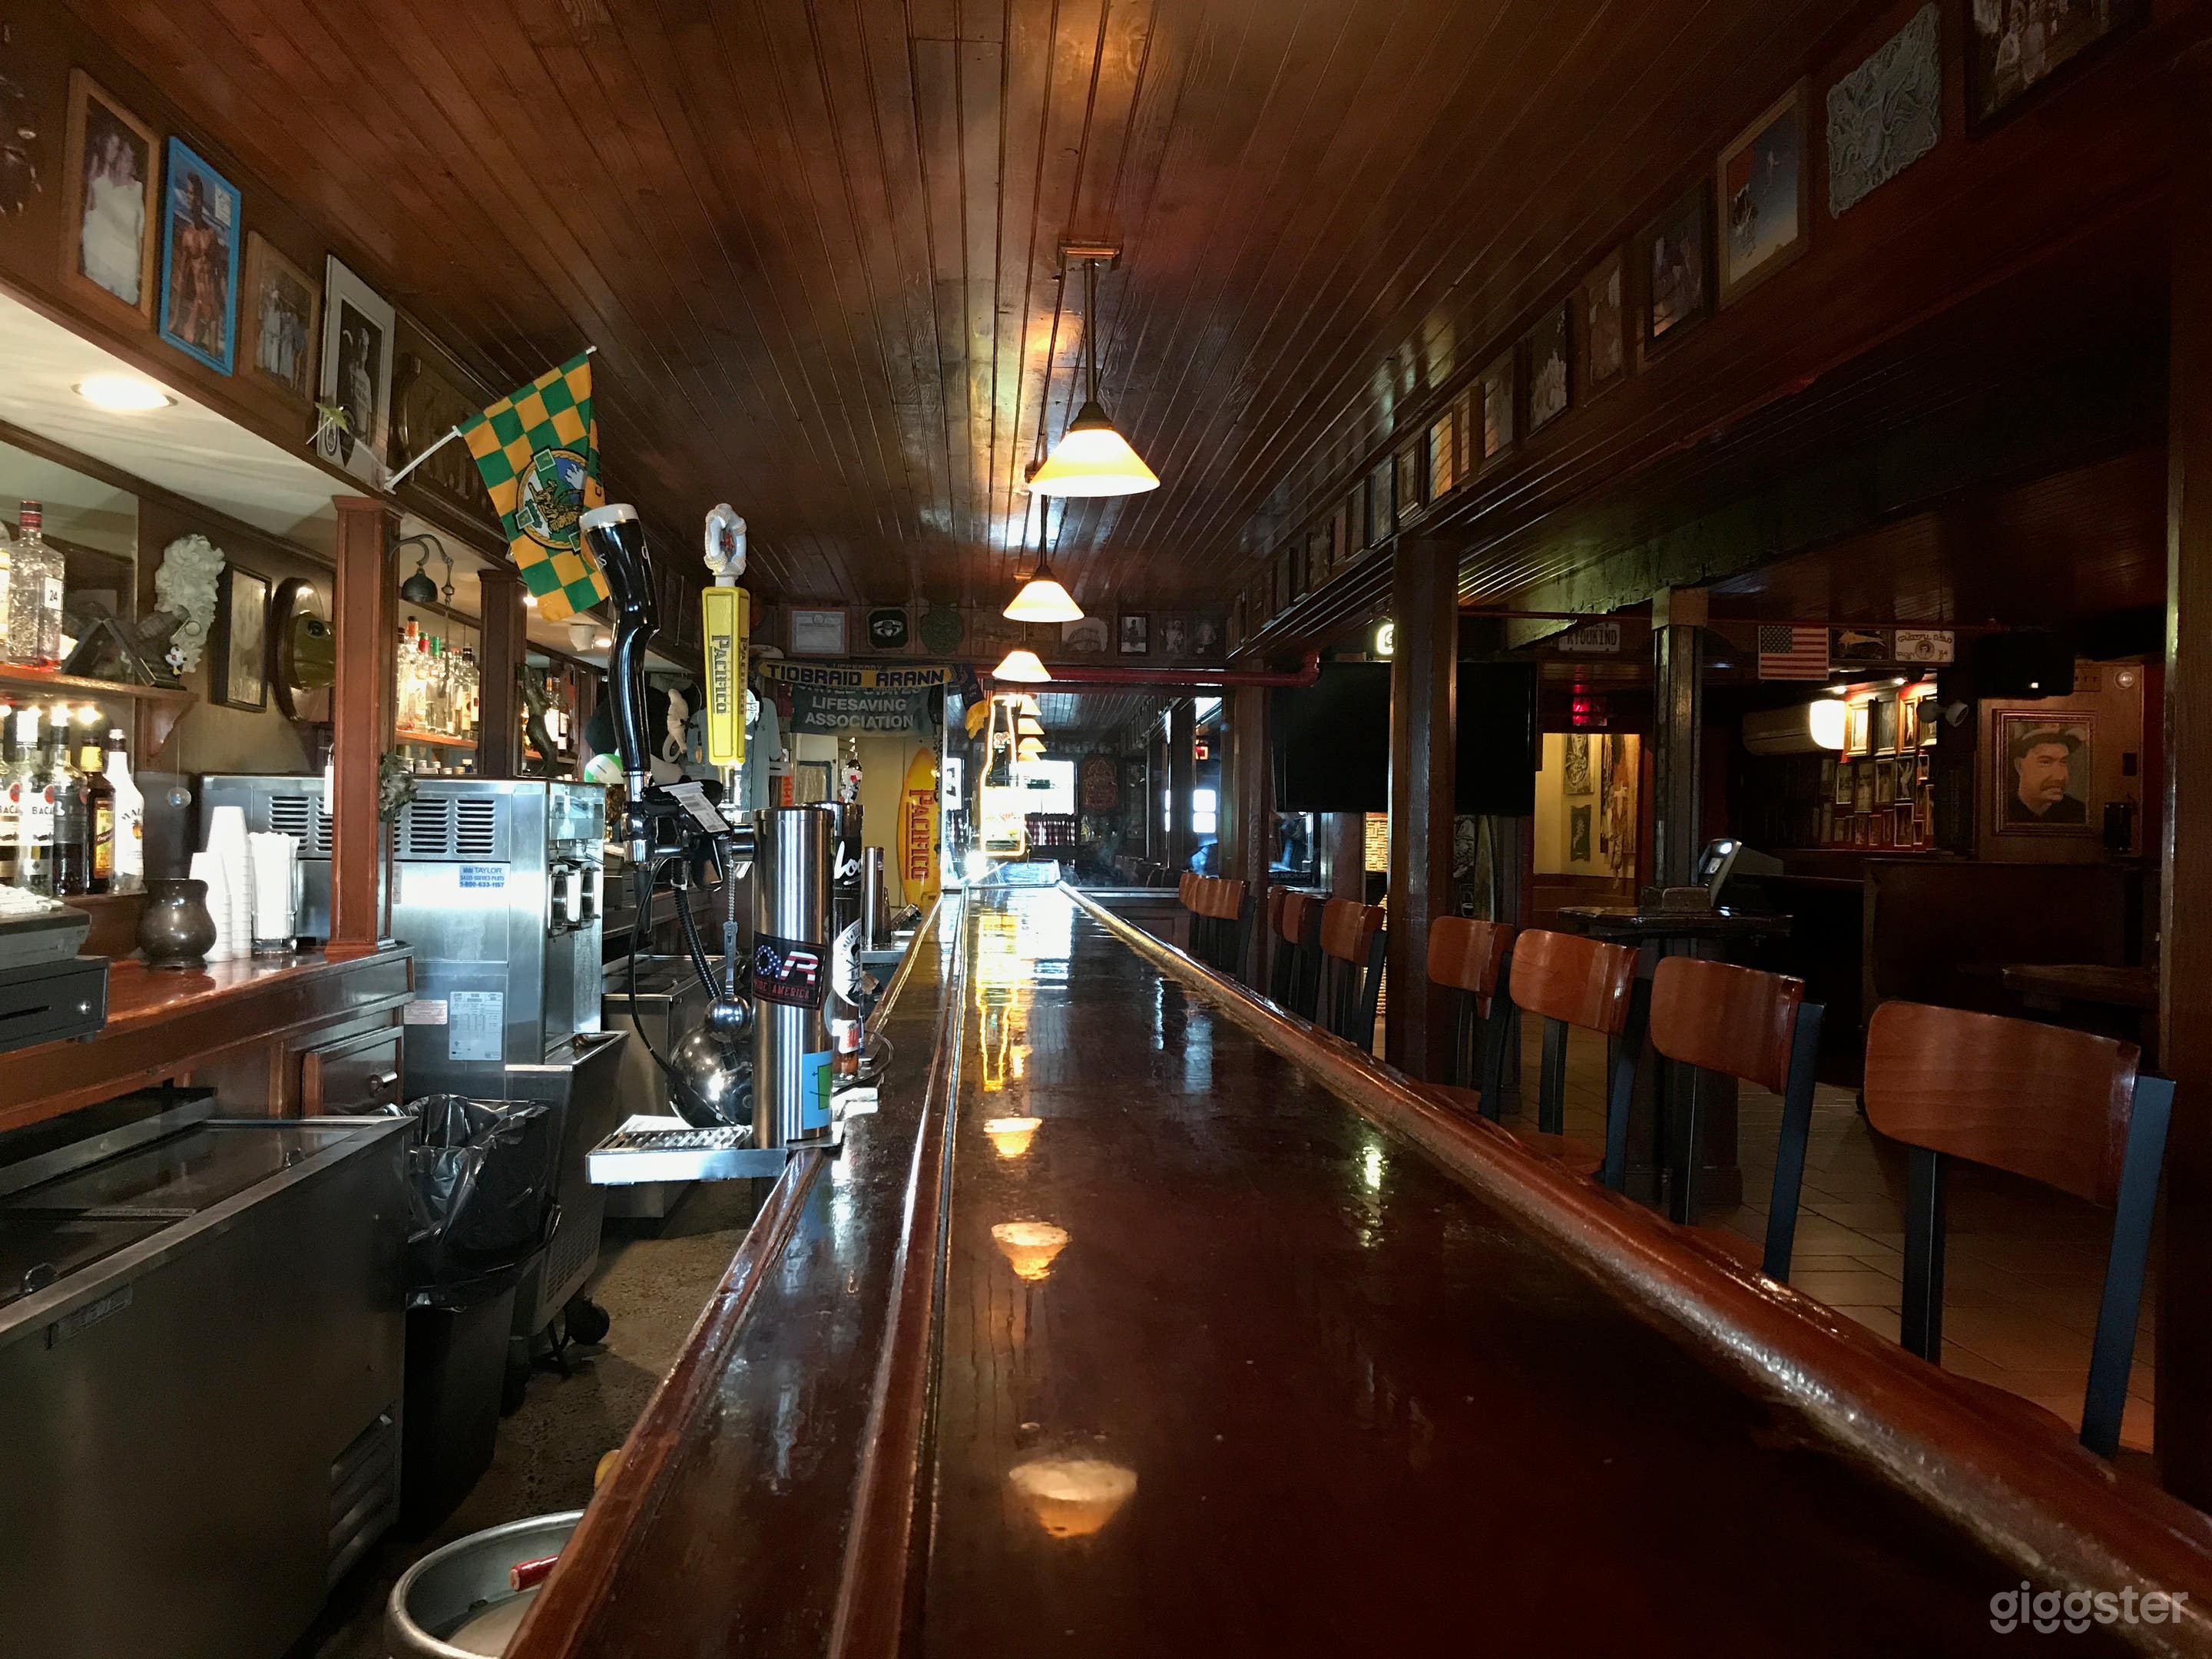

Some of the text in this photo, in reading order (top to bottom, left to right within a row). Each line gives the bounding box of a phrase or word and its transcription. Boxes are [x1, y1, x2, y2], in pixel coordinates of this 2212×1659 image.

[49, 589, 58, 601] 24
[712, 634, 730, 714] PACIFICO
[767, 664, 945, 686] TIOBRAID ARANN
[812, 697, 906, 711] LIFESAVING
[805, 712, 914, 728] ASSOCIATION
[909, 789, 935, 879] PACIFICO
[771, 984, 810, 999] AMERICA
